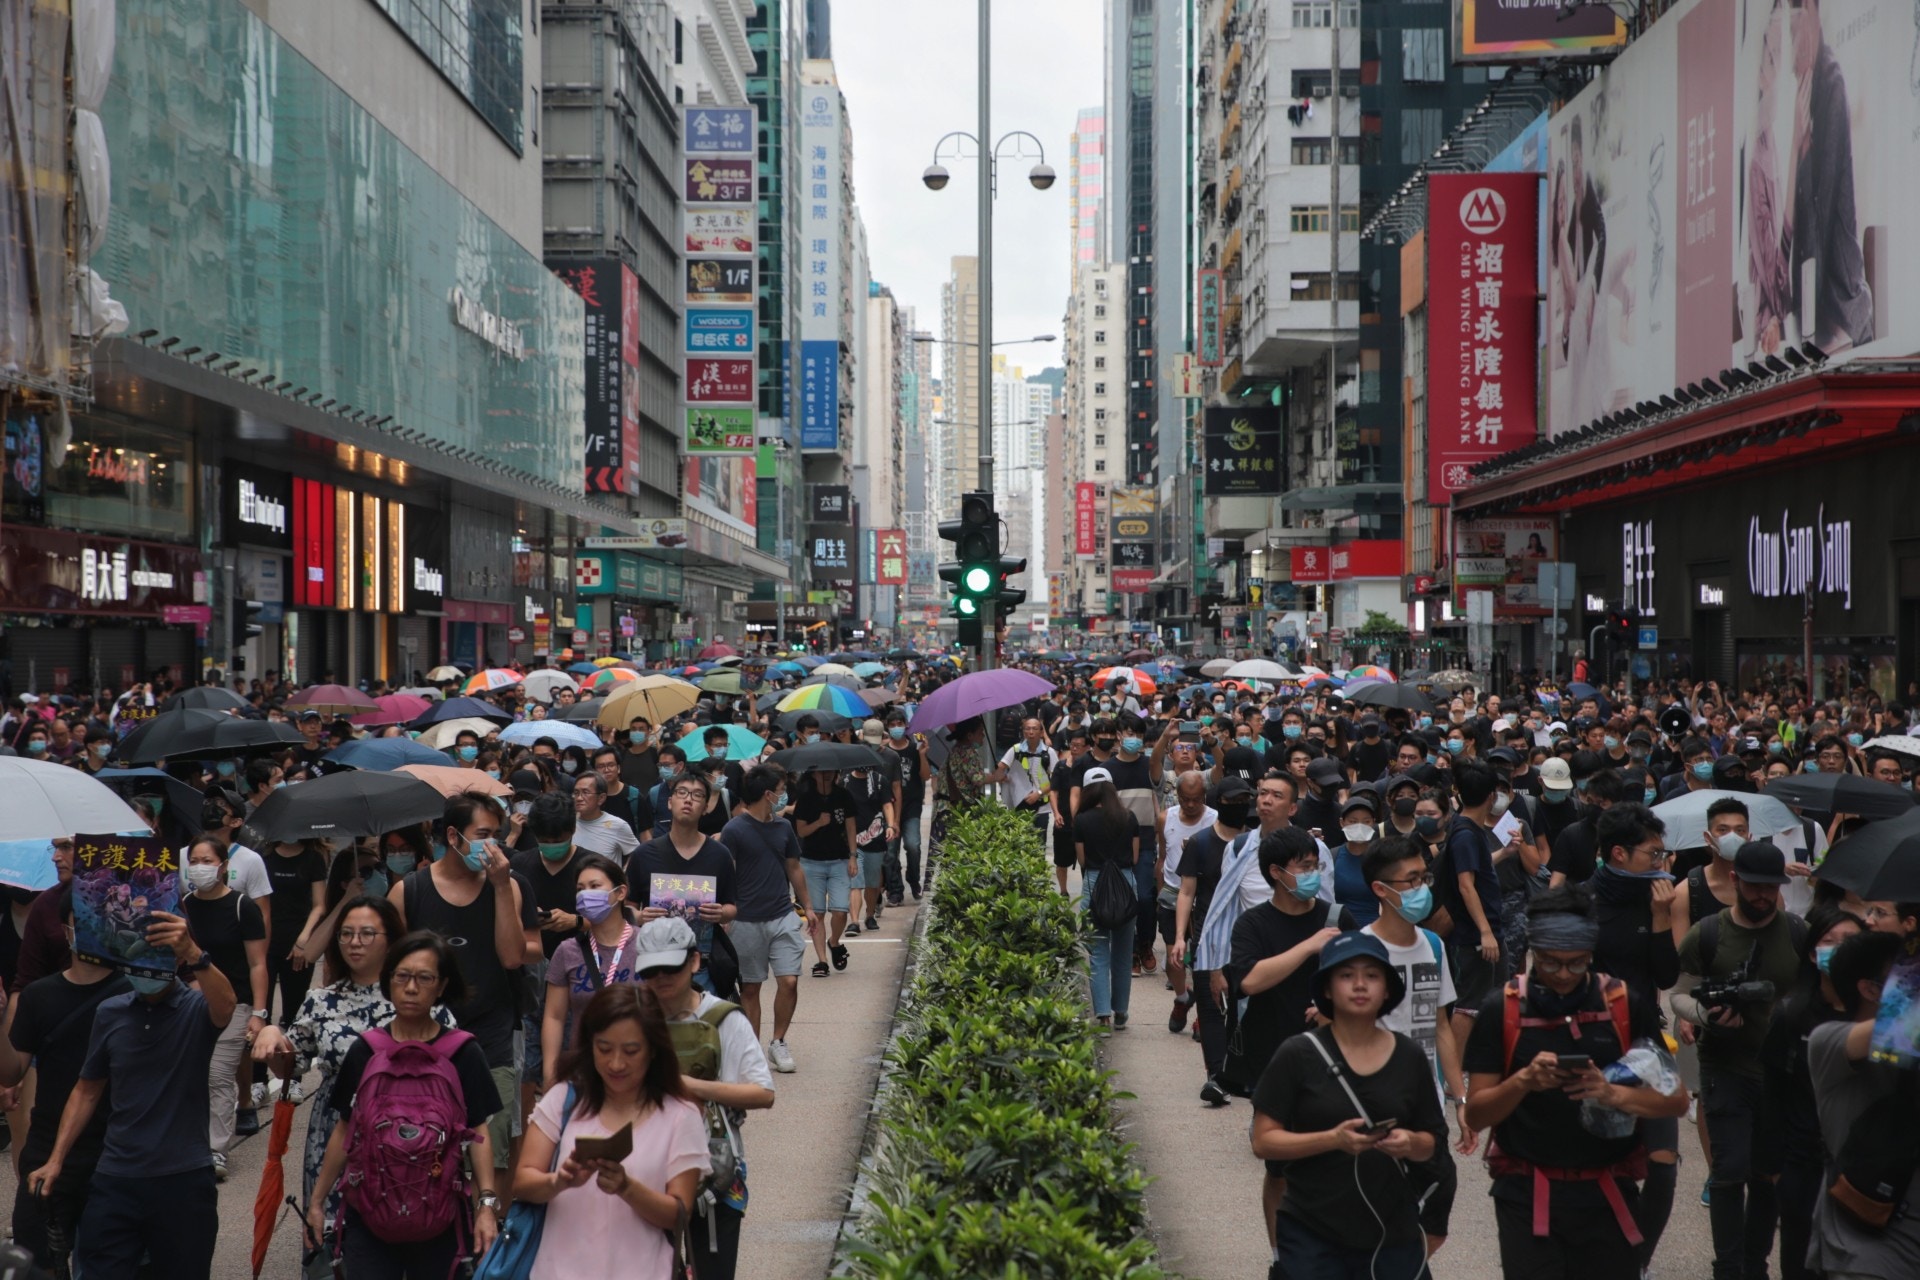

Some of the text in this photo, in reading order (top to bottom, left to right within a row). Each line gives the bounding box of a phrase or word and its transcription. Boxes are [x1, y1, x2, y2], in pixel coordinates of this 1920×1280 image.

[720, 185, 746, 199] 3/F
[726, 268, 750, 285] 1/F
[698, 318, 741, 326] watsons
[691, 333, 730, 346] 屈臣氏
[1461, 241, 1470, 445] CMB WING LUNG BANK
[1474, 241, 1504, 445] 招商永隆銀行
[731, 365, 748, 375] 2/F
[820, 496, 842, 506] 六福
[1458, 519, 1512, 530] sincere
[1533, 521, 1551, 530] MK
[814, 538, 846, 559] 周生生
[882, 534, 902, 578] 六福
[1748, 502, 1851, 610] Chow Sang Sang
[81, 548, 128, 601] 周大福
[776, 605, 816, 617] 生銀行
[1207, 602, 1221, 620] 六
[77, 844, 179, 872] 守護未來
[653, 878, 715, 893] 守護未來
